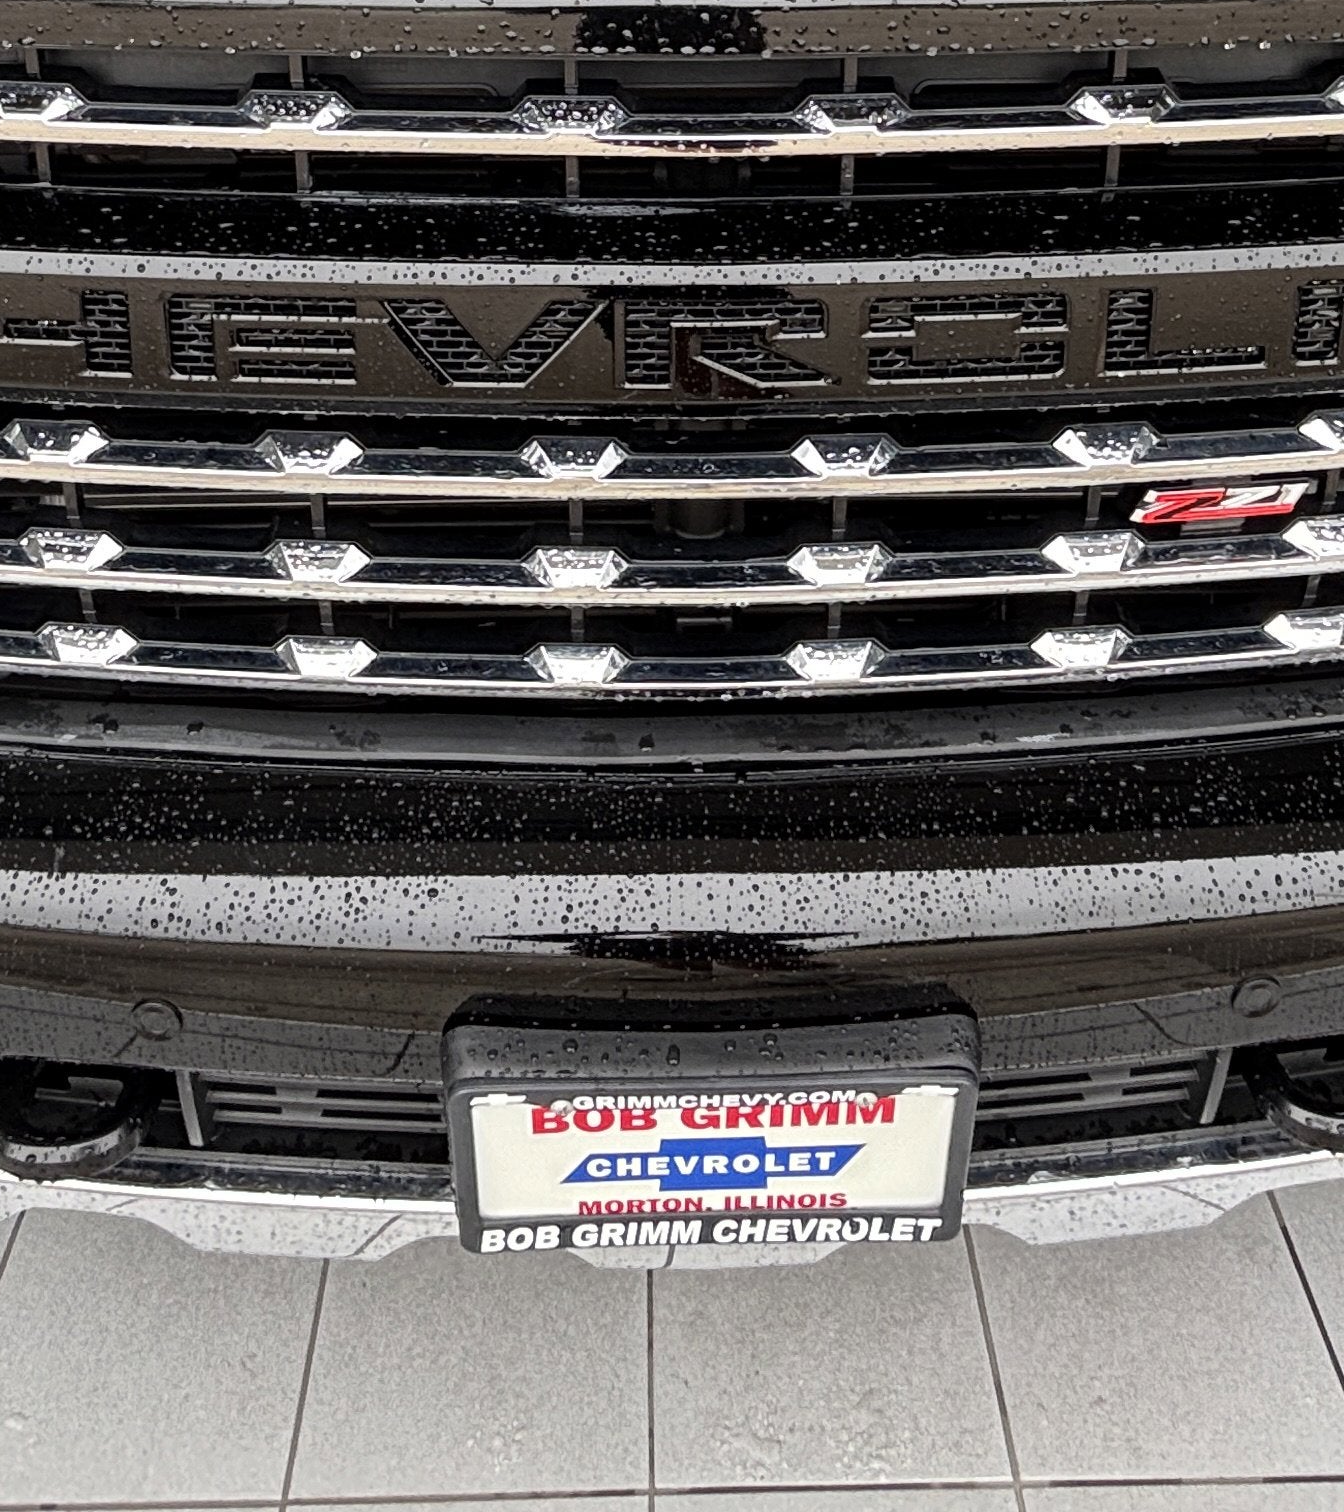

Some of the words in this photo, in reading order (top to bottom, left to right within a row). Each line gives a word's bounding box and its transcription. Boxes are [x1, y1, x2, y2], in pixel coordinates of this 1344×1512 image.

[1129, 483, 1310, 523] Z71
[532, 1104, 658, 1134] BOB
[680, 1096, 896, 1129] GRIMM
[572, 1090, 856, 1110] GRIMMCHEVY.COM
[586, 1151, 837, 1178] CHEVROLET
[724, 1193, 848, 1211] ILLINOIS
[480, 1224, 562, 1253] BOB
[572, 1219, 703, 1248] GRIMM
[712, 1217, 943, 1243] CHEVROLET
